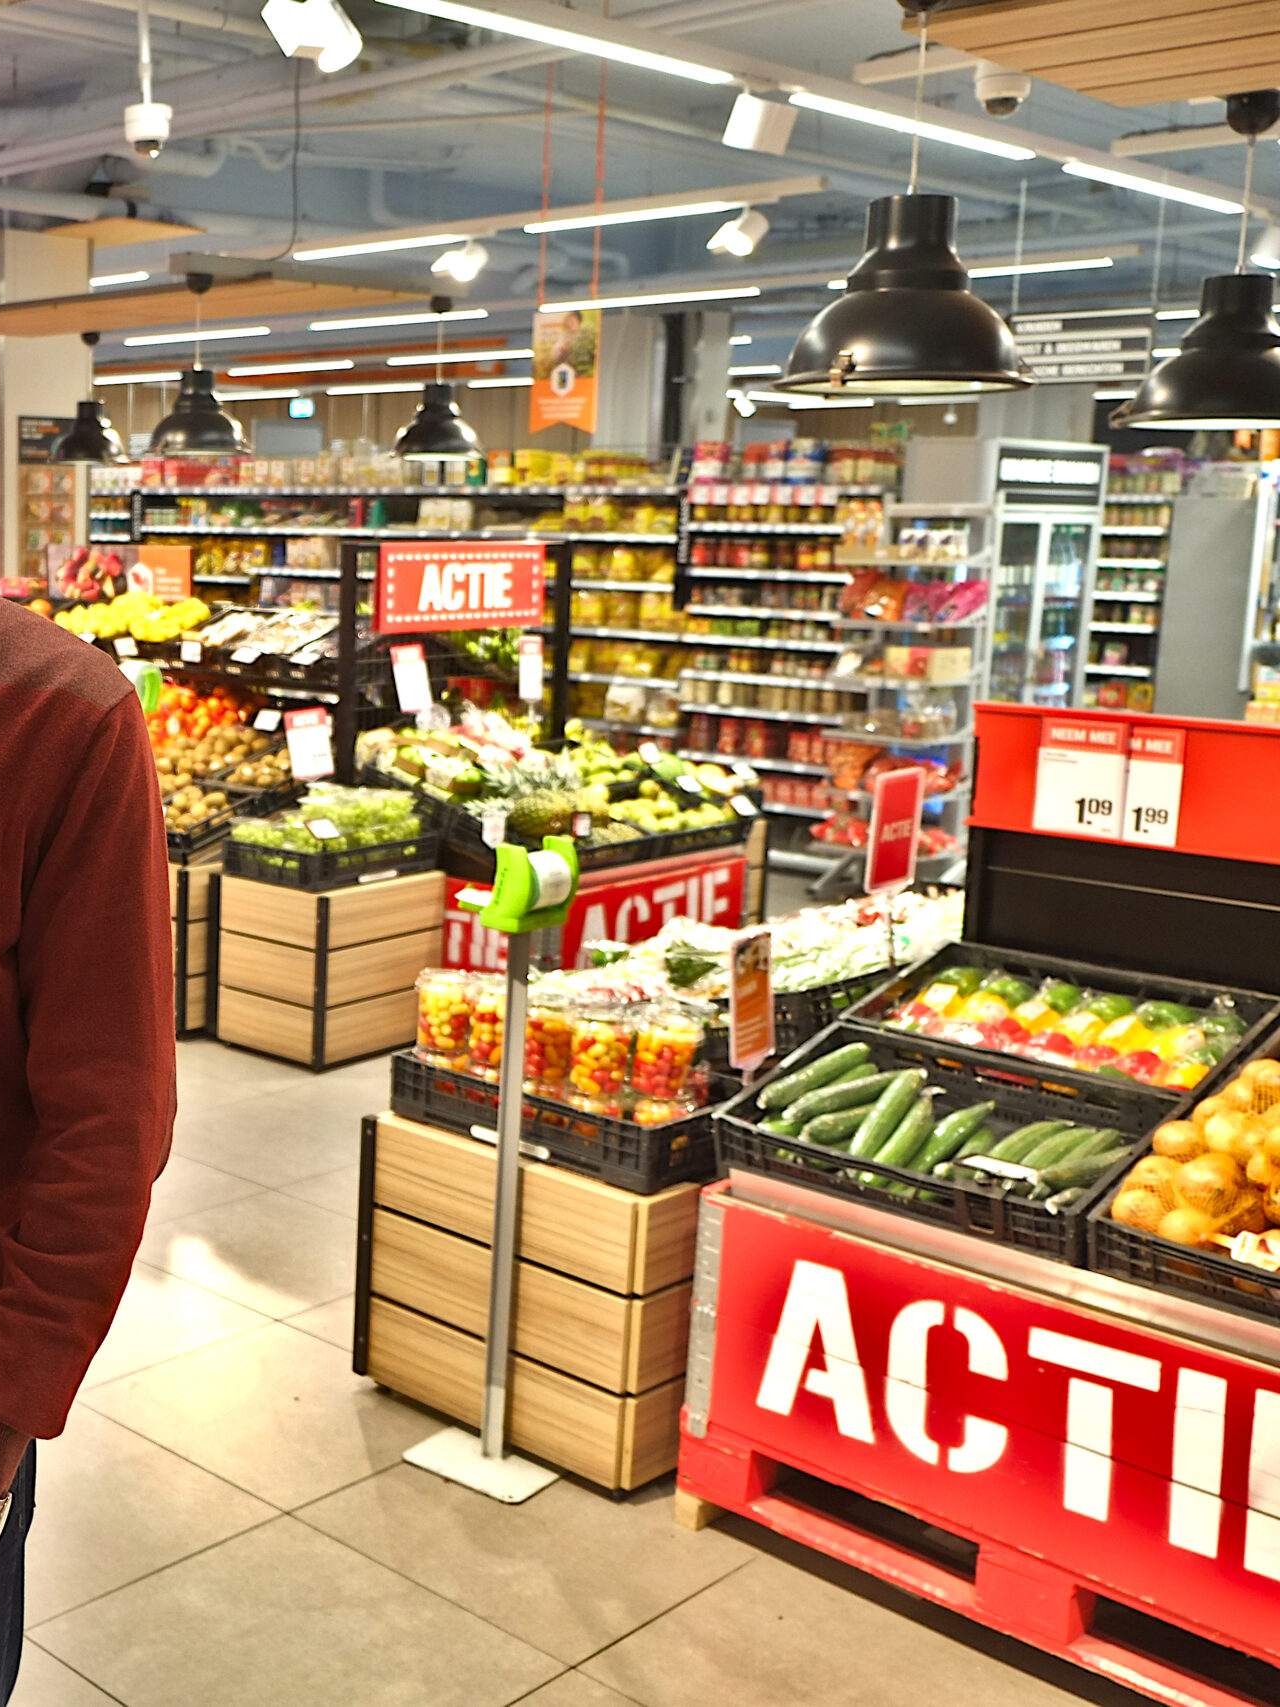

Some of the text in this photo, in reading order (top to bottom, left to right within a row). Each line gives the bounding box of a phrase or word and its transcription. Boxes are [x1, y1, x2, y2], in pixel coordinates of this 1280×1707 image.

[417, 562, 514, 612] ACTIE
[1051, 727, 1087, 742] NEEM
[1089, 730, 1117, 745] MEE
[1144, 738, 1174, 754] MEE
[1075, 797, 1113, 825] 1.09
[1131, 807, 1169, 834] 1.99
[881, 819, 915, 843] ACTIE
[575, 866, 731, 969] ACTIE
[444, 909, 510, 972] TIE
